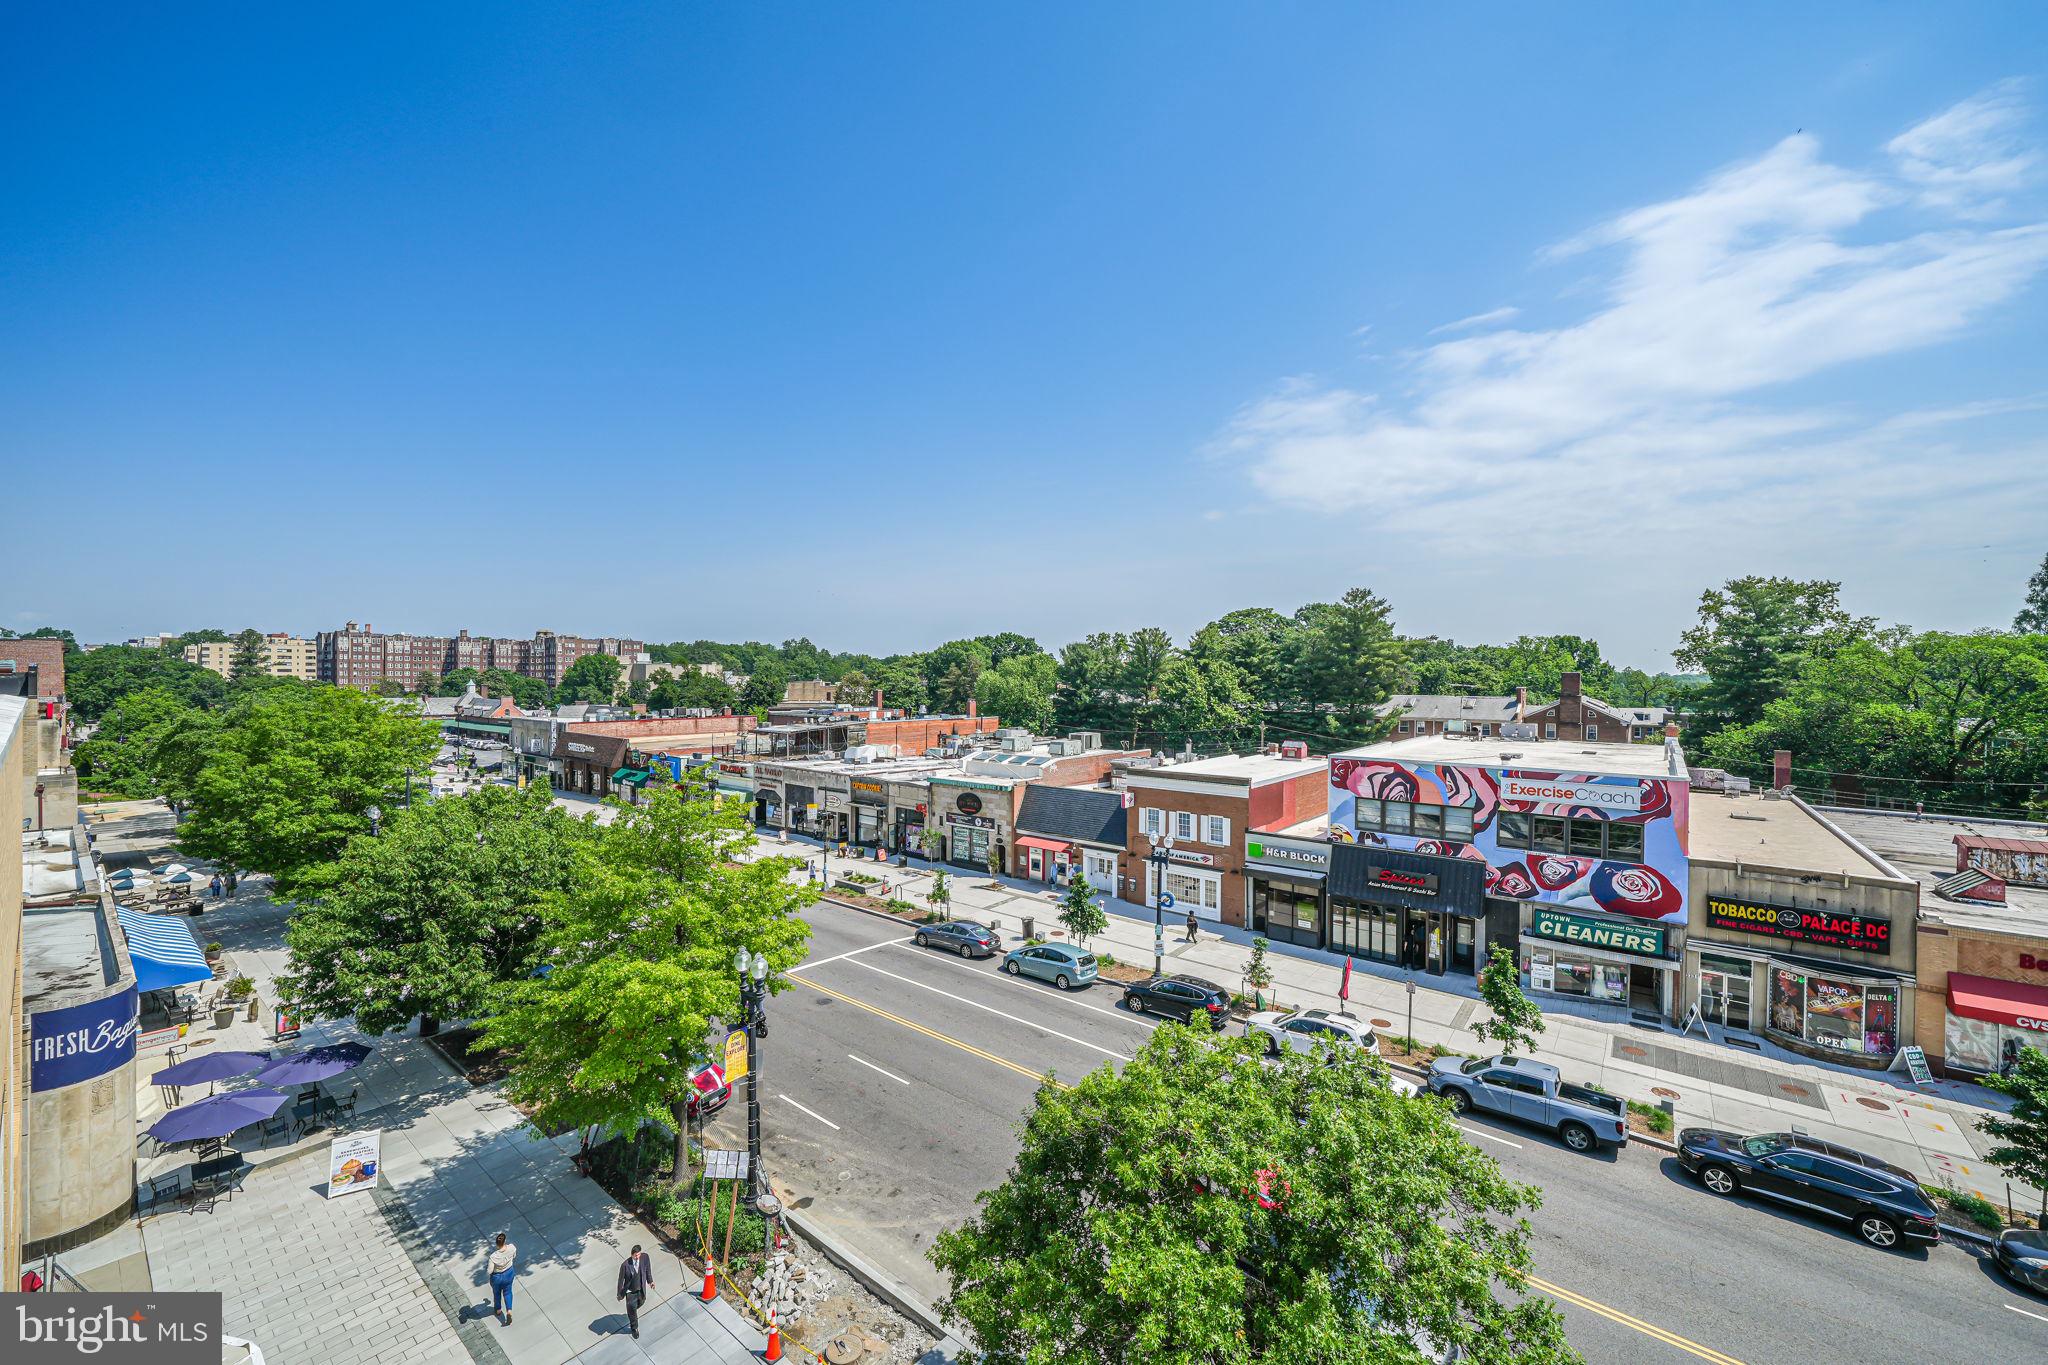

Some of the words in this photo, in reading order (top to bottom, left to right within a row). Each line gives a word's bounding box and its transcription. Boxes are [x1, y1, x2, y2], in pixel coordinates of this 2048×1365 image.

[1175, 853, 1200, 862] AMERICA
[1266, 847, 1287, 859] H&R
[1290, 852, 1326, 864] BLOCK
[1378, 869, 1426, 886] Spices
[1381, 882, 1407, 892] Restaurant
[1540, 912, 1571, 923] UPTOWN
[1709, 901, 1777, 923] TOBACCO
[1801, 914, 1861, 936] PALACE
[1866, 924, 1888, 939] DC
[1539, 920, 1656, 952] CLEANERS
[1594, 921, 1625, 931] Professional
[1625, 926, 1634, 934] Dry
[1635, 927, 1657, 937] Cleaning
[1716, 919, 1737, 929] FINE
[1739, 922, 1775, 934] CIGARS
[1782, 929, 1803, 938] CBD
[1811, 933, 1838, 943] VAPE
[1847, 939, 1878, 950] GIFTS
[1779, 970, 1797, 982] CBD
[1817, 984, 1848, 997] VAPOR
[1867, 993, 1888, 1001] DELTA
[2016, 1017, 2048, 1032] CVS
[34, 1028, 89, 1061] FRESH
[1816, 1035, 1846, 1049] OPEN
[726, 1045, 745, 1056] EXPLORE
